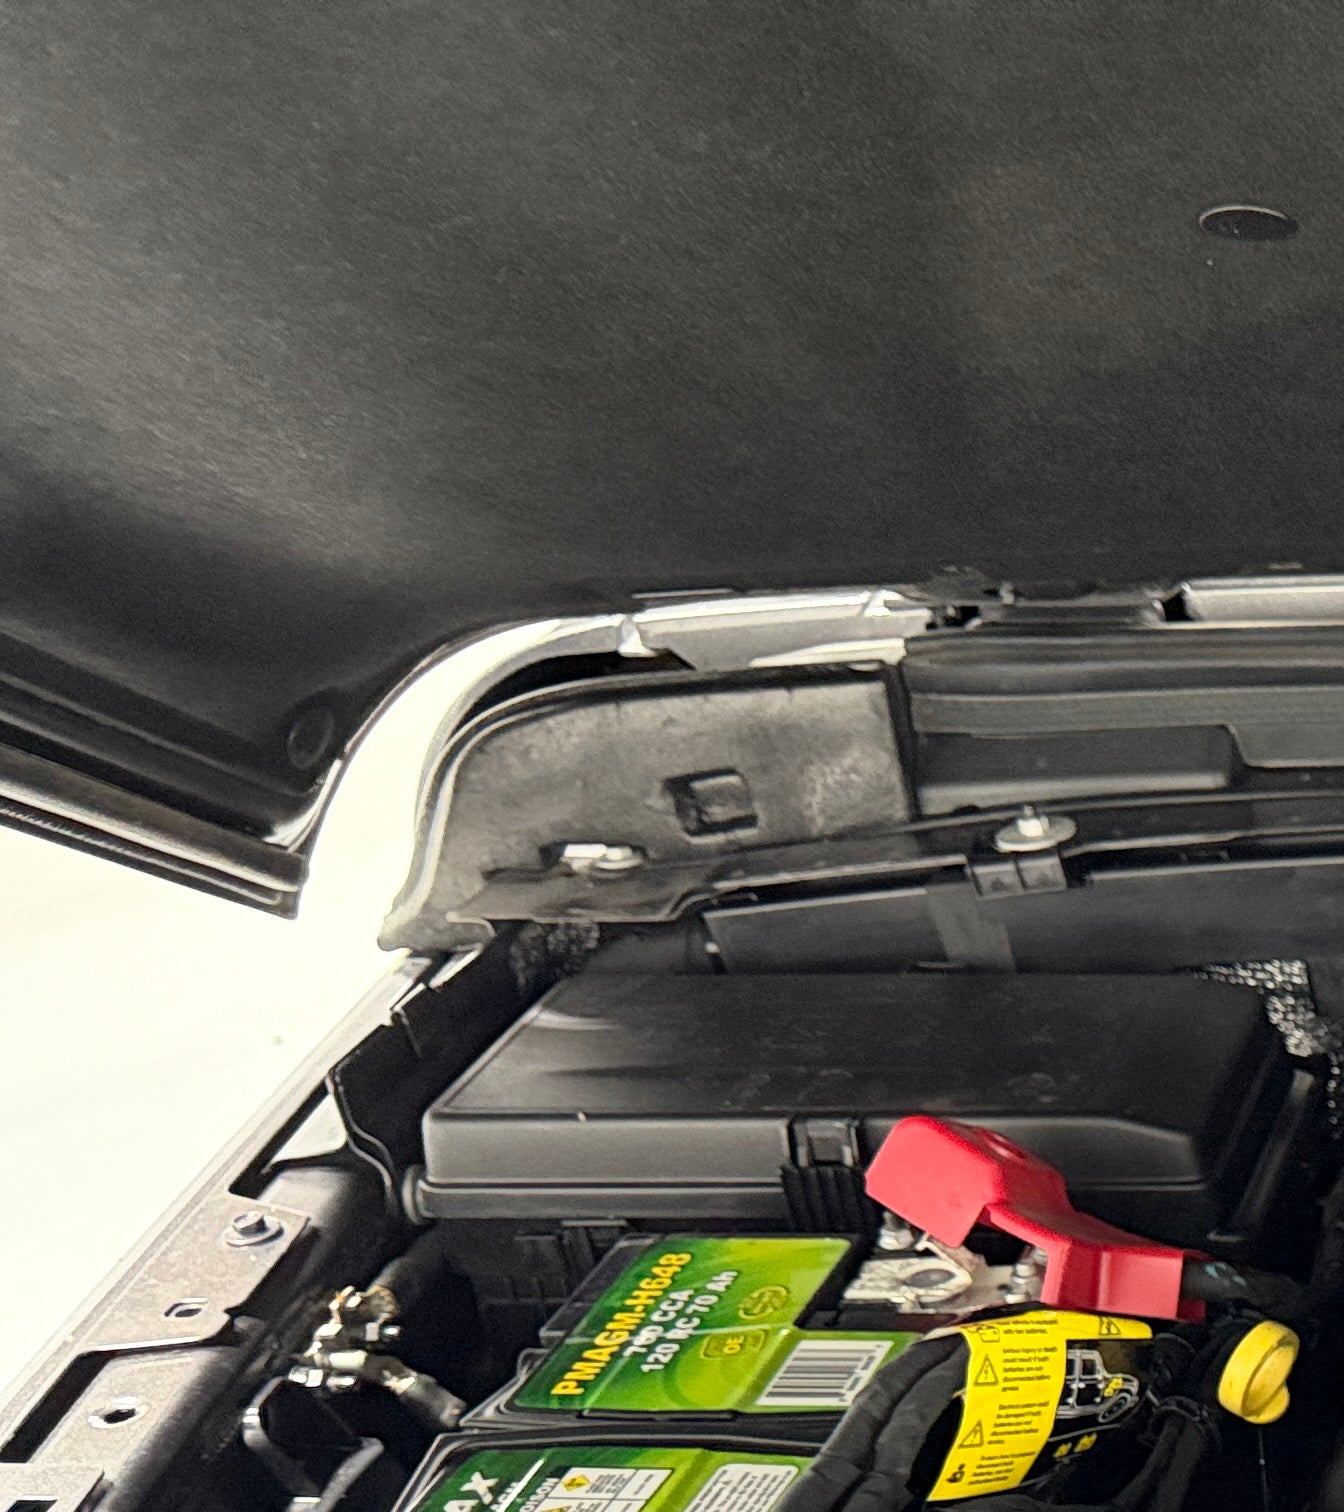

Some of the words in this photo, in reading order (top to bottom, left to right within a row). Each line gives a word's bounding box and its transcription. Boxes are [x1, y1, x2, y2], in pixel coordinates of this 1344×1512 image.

[550, 1252, 693, 1396] PMAGM-H648
[640, 1342, 681, 1373] 120
[685, 1293, 720, 1315] 70
[705, 1270, 740, 1293] Ah
[650, 1288, 695, 1323] CCA
